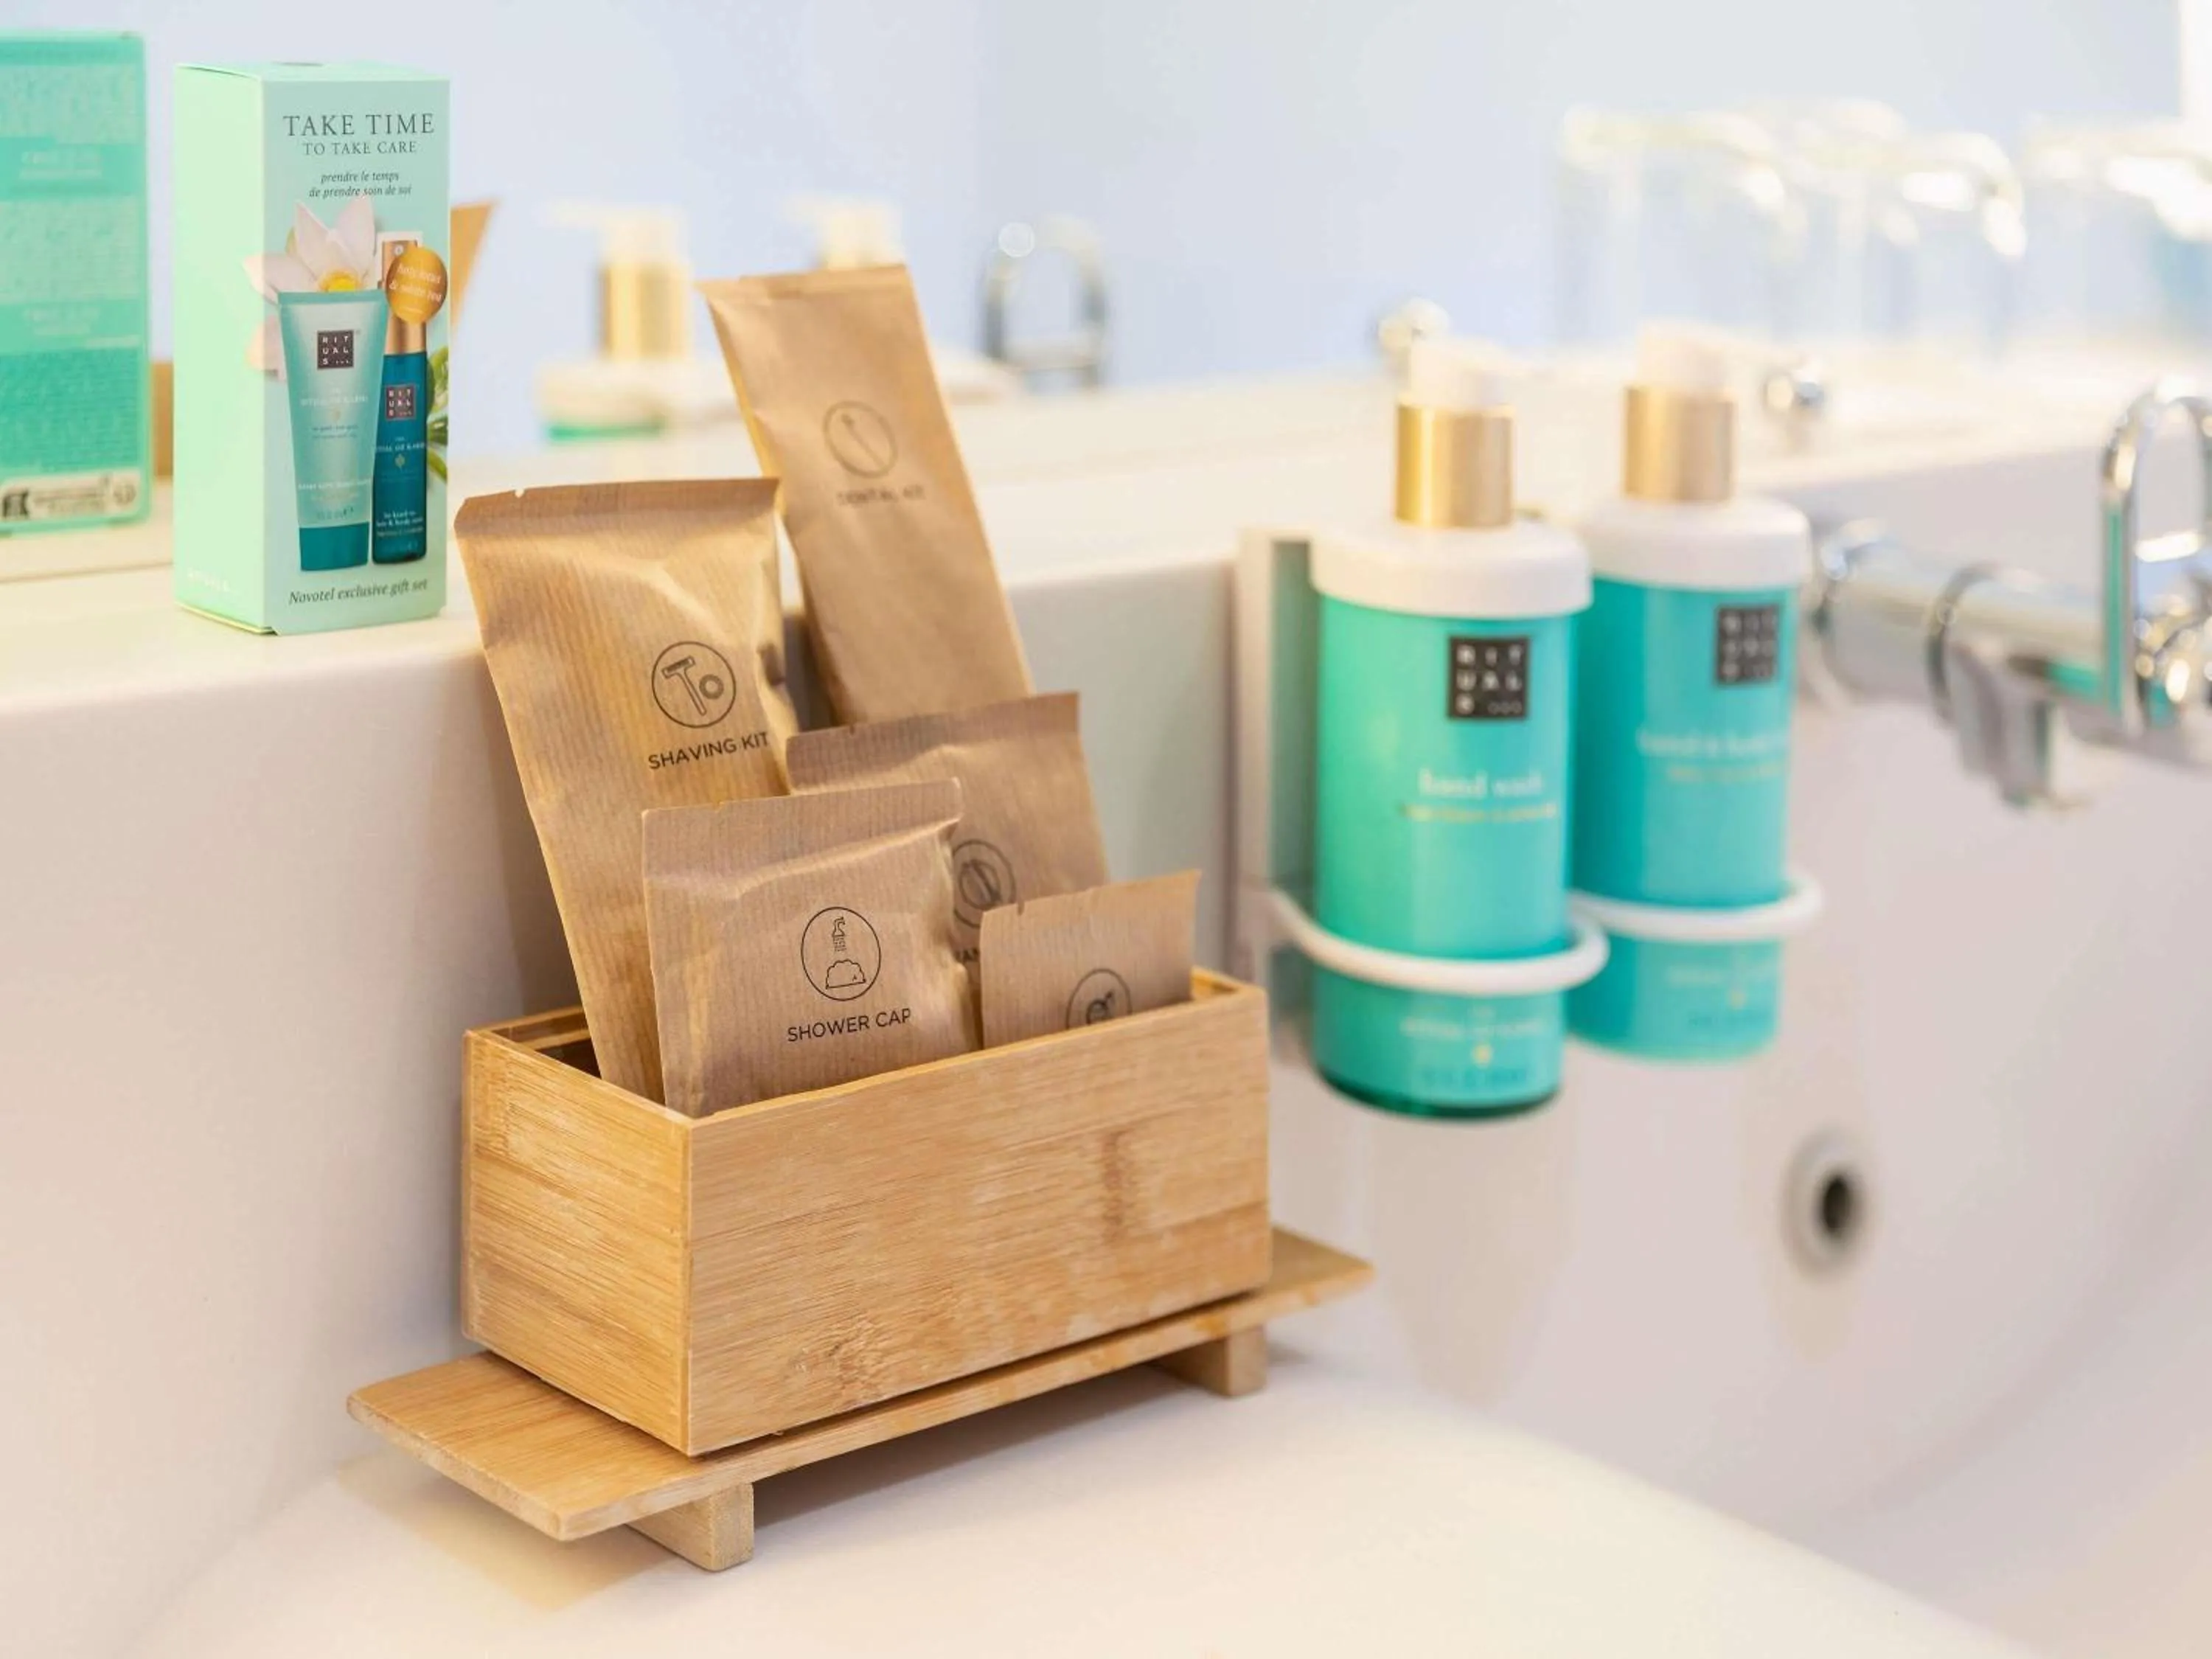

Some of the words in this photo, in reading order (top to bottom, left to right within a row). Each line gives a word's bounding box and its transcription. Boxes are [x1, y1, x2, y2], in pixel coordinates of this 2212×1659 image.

[283, 115, 355, 136] TAKE
[366, 113, 435, 135] TIME
[302, 142, 326, 156] TO
[331, 141, 372, 155] TAKE
[377, 140, 417, 154] CARE
[321, 172, 358, 184] prendre
[361, 171, 369, 181] le
[372, 172, 400, 183] temps
[309, 187, 320, 197] de
[322, 185, 361, 199] prendre
[364, 186, 383, 196] soin
[385, 184, 397, 195] de
[288, 588, 335, 605] Novotel
[338, 582, 386, 599] exclusive
[389, 580, 410, 597] gift
[413, 578, 428, 591] set
[648, 738, 737, 770] SHAVING
[741, 731, 769, 750] KIT
[787, 1015, 871, 1042] SHOWER
[875, 1007, 912, 1027] CAP
